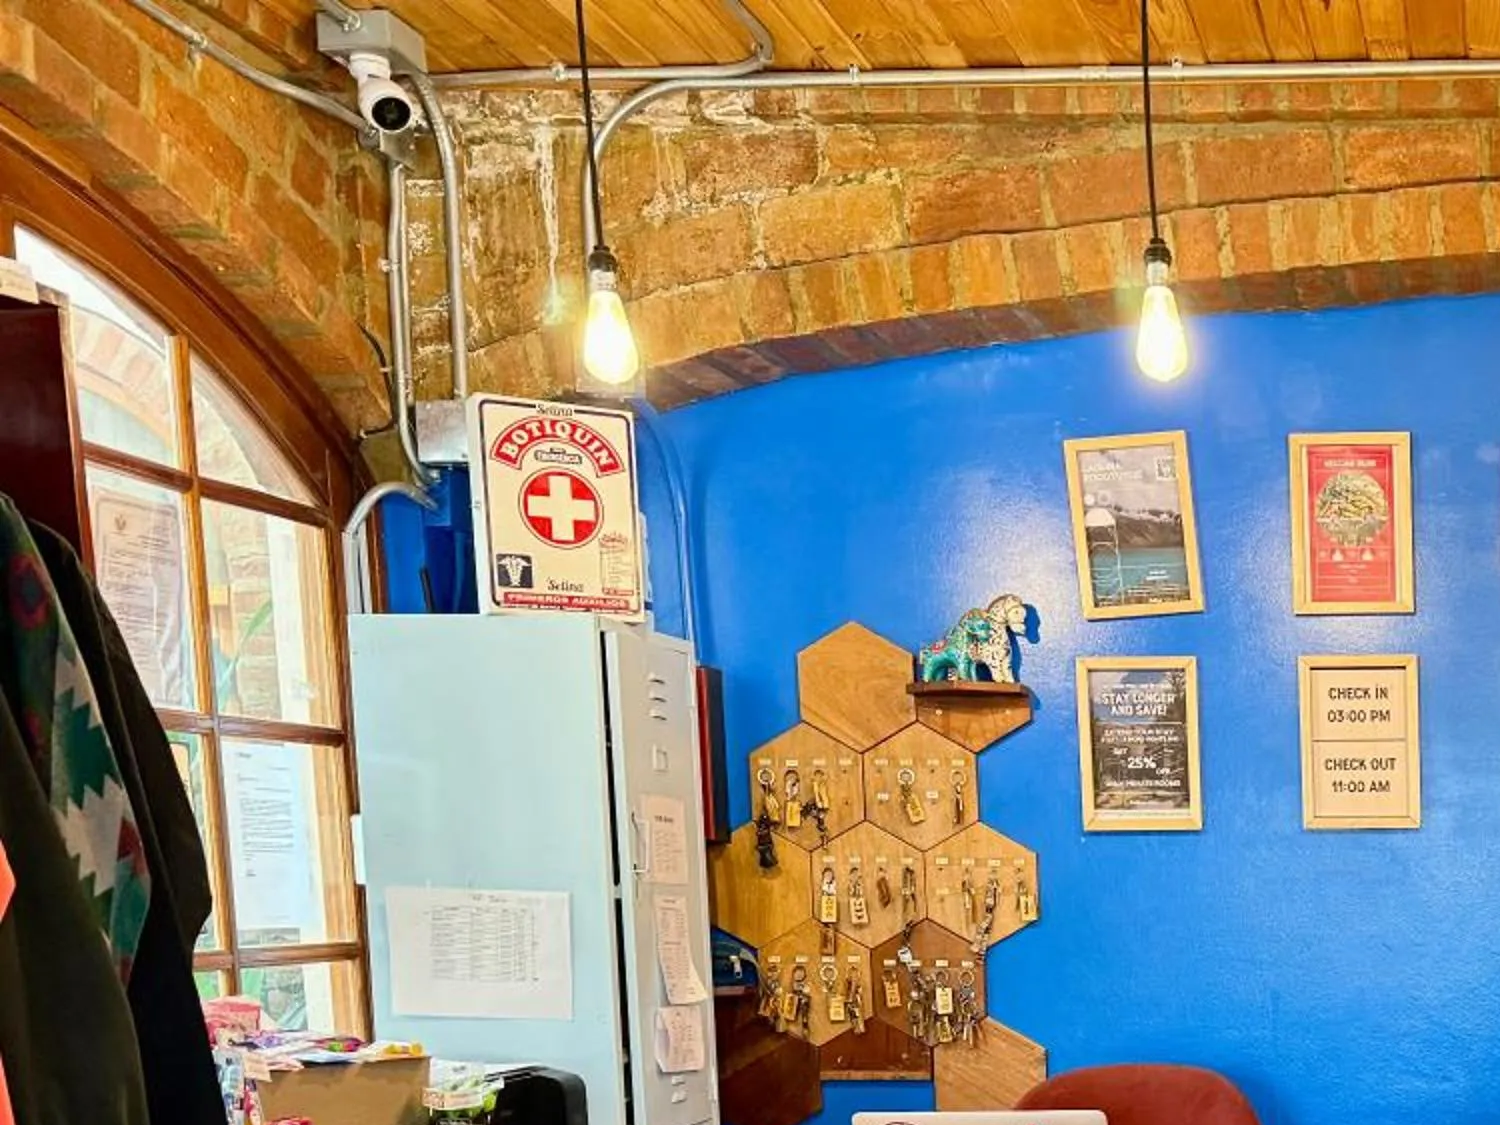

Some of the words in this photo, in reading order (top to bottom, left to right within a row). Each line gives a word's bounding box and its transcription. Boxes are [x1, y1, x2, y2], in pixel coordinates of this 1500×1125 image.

[498, 418, 616, 472] BOTIQUIN
[1102, 692, 1129, 704] STAY
[1132, 692, 1177, 704] LONGER
[1328, 687, 1371, 700] CHECK
[1375, 686, 1389, 699] IN
[1110, 704, 1134, 716] AND
[1327, 709, 1367, 723] 03:00
[1370, 709, 1391, 722] PM
[1127, 757, 1157, 769] 25%
[1324, 758, 1367, 771] CHECK
[1370, 757, 1397, 771] OUT
[1331, 780, 1366, 793] 11:00
[1369, 780, 1391, 793] AM
